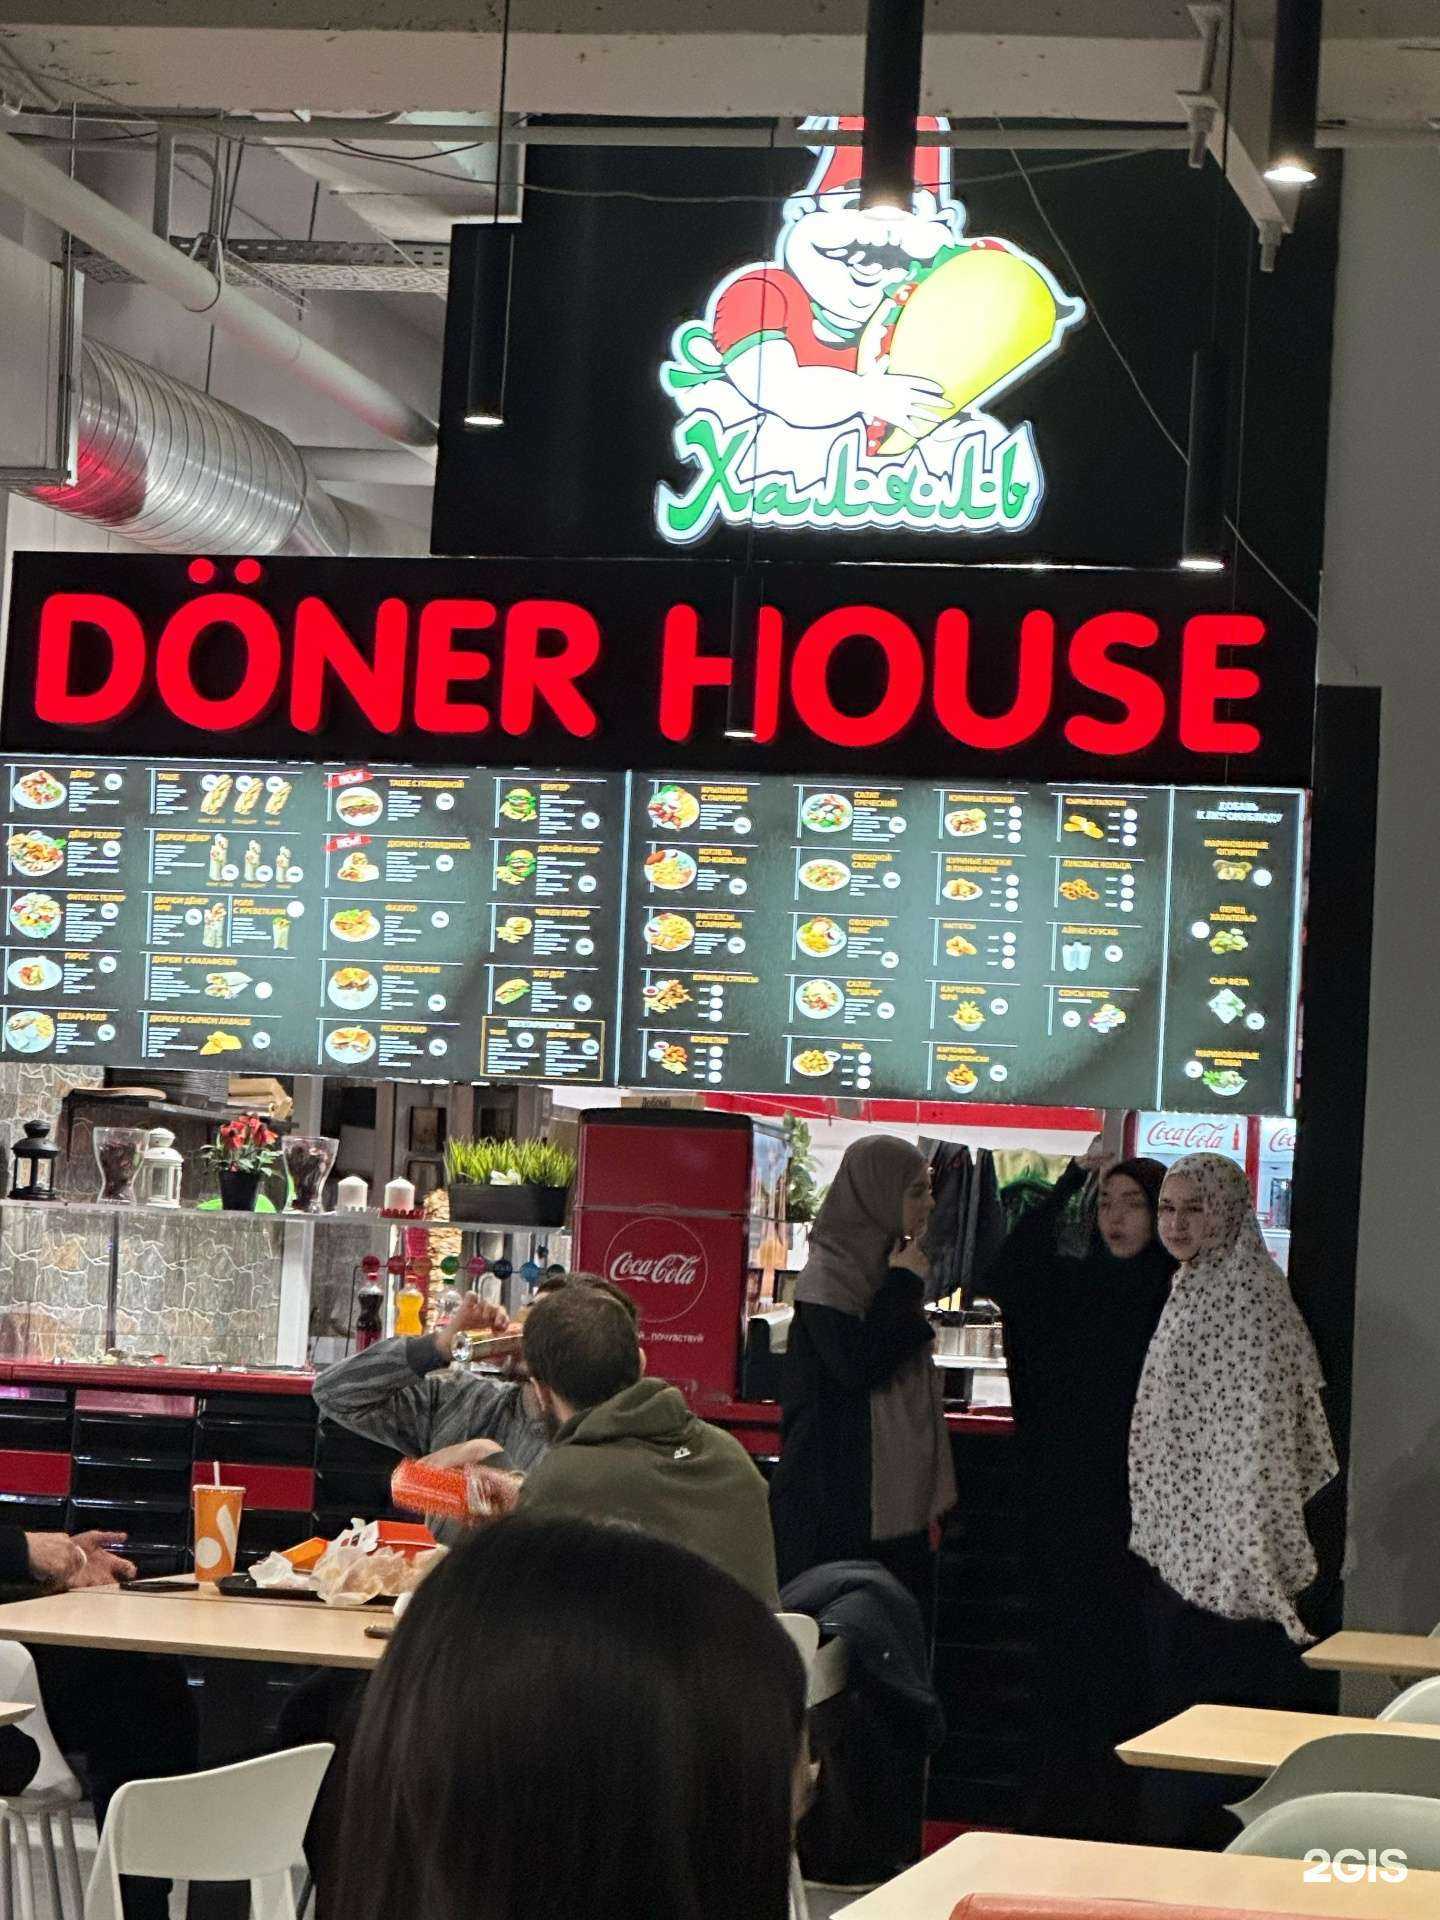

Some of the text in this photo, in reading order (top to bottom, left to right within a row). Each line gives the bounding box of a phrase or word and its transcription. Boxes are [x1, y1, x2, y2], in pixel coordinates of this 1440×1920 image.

[34, 558, 1266, 756] DÖNER HOUSE
[1147, 1119, 1229, 1149] Coca-Cola
[610, 1251, 701, 1286] Coca-Cola
